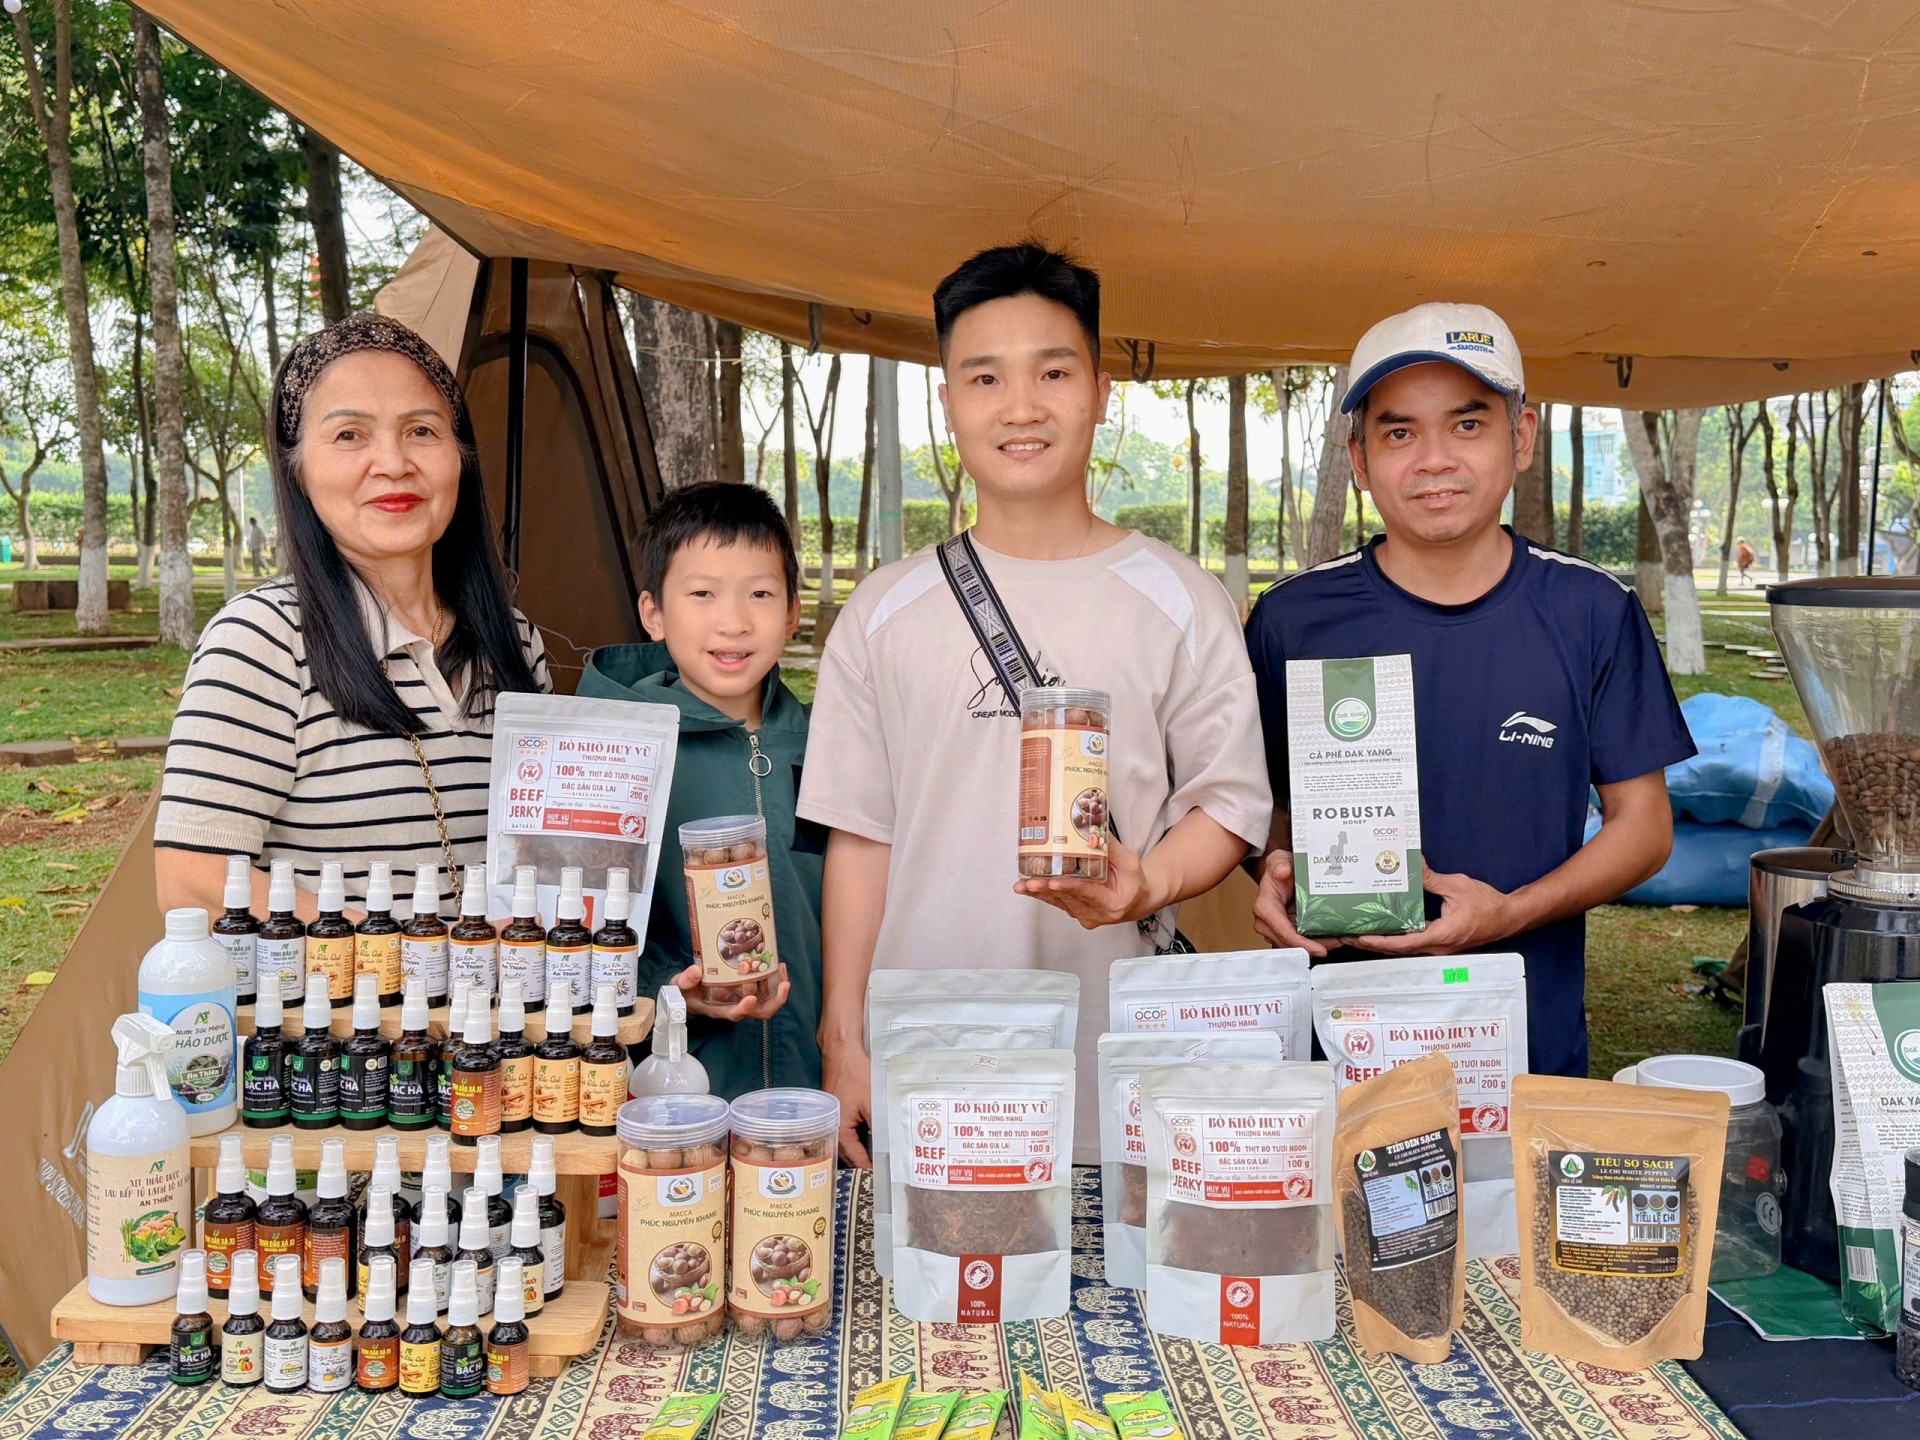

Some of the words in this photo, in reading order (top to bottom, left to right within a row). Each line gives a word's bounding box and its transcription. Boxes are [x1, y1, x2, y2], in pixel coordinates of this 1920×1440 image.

[1450, 331, 1491, 345] LARUE
[1456, 344, 1488, 353] SMOOTH
[518, 739, 548, 748] OCOP
[1498, 729, 1555, 749] LI-NING
[559, 739, 575, 752] BÒ
[578, 740, 604, 753] KHÔ
[606, 744, 632, 756] HUY
[635, 745, 652, 758] VŨ
[1309, 750, 1322, 760] CÀ
[1325, 749, 1343, 759] PHÊ
[1345, 749, 1364, 758] DAK
[1366, 748, 1393, 757] YANG
[556, 765, 585, 777] 100%
[630, 774, 649, 783] NGON
[592, 784, 604, 792] GIA
[605, 785, 617, 793] LAI
[510, 788, 545, 802] BEEF
[630, 790, 643, 800] 200
[509, 805, 542, 818] JERKY
[1312, 805, 1396, 820] ROBUSTA
[1373, 827, 1398, 835] OCOP
[1313, 856, 1330, 864] DAK
[1334, 855, 1359, 864] YANG
[1135, 1009, 1167, 1021] OCOP
[1179, 1005, 1198, 1020] BÒ
[1201, 1003, 1231, 1018] KHÔ
[1234, 1004, 1262, 1017] HUY
[1264, 1000, 1283, 1015] VŨ
[1389, 1026, 1409, 1041] BÒ
[1413, 1025, 1445, 1041] KHÔ
[1448, 1026, 1477, 1039] HUY
[1480, 1022, 1500, 1037] VŨ
[174, 1036, 201, 1049] HẢO
[1460, 1058, 1478, 1068] TƯƠI
[1480, 1059, 1501, 1067] NGON
[199, 1069, 220, 1078] Thiên
[263, 1078, 280, 1089] HÀ
[1456, 1077, 1464, 1085] IA
[1465, 1076, 1476, 1084] LAI
[1481, 1079, 1498, 1088] 200
[917, 1102, 941, 1110] OCOP
[954, 1100, 970, 1113] BÒ
[973, 1100, 1000, 1113] KHÔ
[1002, 1103, 1028, 1113] HUY
[1031, 1100, 1048, 1113] VŨ
[1881, 1097, 1904, 1107] DAK
[1170, 1117, 1195, 1125] OCOP
[1208, 1115, 1225, 1128] BÒ
[1228, 1115, 1256, 1128] KHÔ
[1259, 1117, 1286, 1128] HUY
[1288, 1115, 1306, 1128] VŨ
[953, 1125, 984, 1137] 100%
[914, 1145, 946, 1160] BEEF
[1028, 1144, 1044, 1153] 100
[1208, 1141, 1241, 1153] 100%
[1172, 1158, 1202, 1175] BEEF
[1287, 1159, 1302, 1168] 100
[1593, 1156, 1621, 1167] TIÊU
[1624, 1158, 1640, 1170] SỌ
[1643, 1159, 1675, 1170] SẠCH
[914, 1162, 946, 1177] JERKY
[1172, 1175, 1202, 1191] JERKY
[139, 1199, 150, 1207] AN
[153, 1194, 173, 1206] THIÊN
[669, 1209, 693, 1218] MACCA
[743, 1206, 761, 1217] PHÚC
[762, 1209, 794, 1218] NGUYÊN
[795, 1206, 820, 1217] KHANG
[640, 1218, 661, 1227] PHÚC
[662, 1217, 695, 1227] NGUYÊN
[695, 1210, 717, 1223] KHANG
[969, 1300, 986, 1308] 100%
[1230, 1313, 1249, 1321] 100%
[1223, 1321, 1256, 1330] NATURAL
